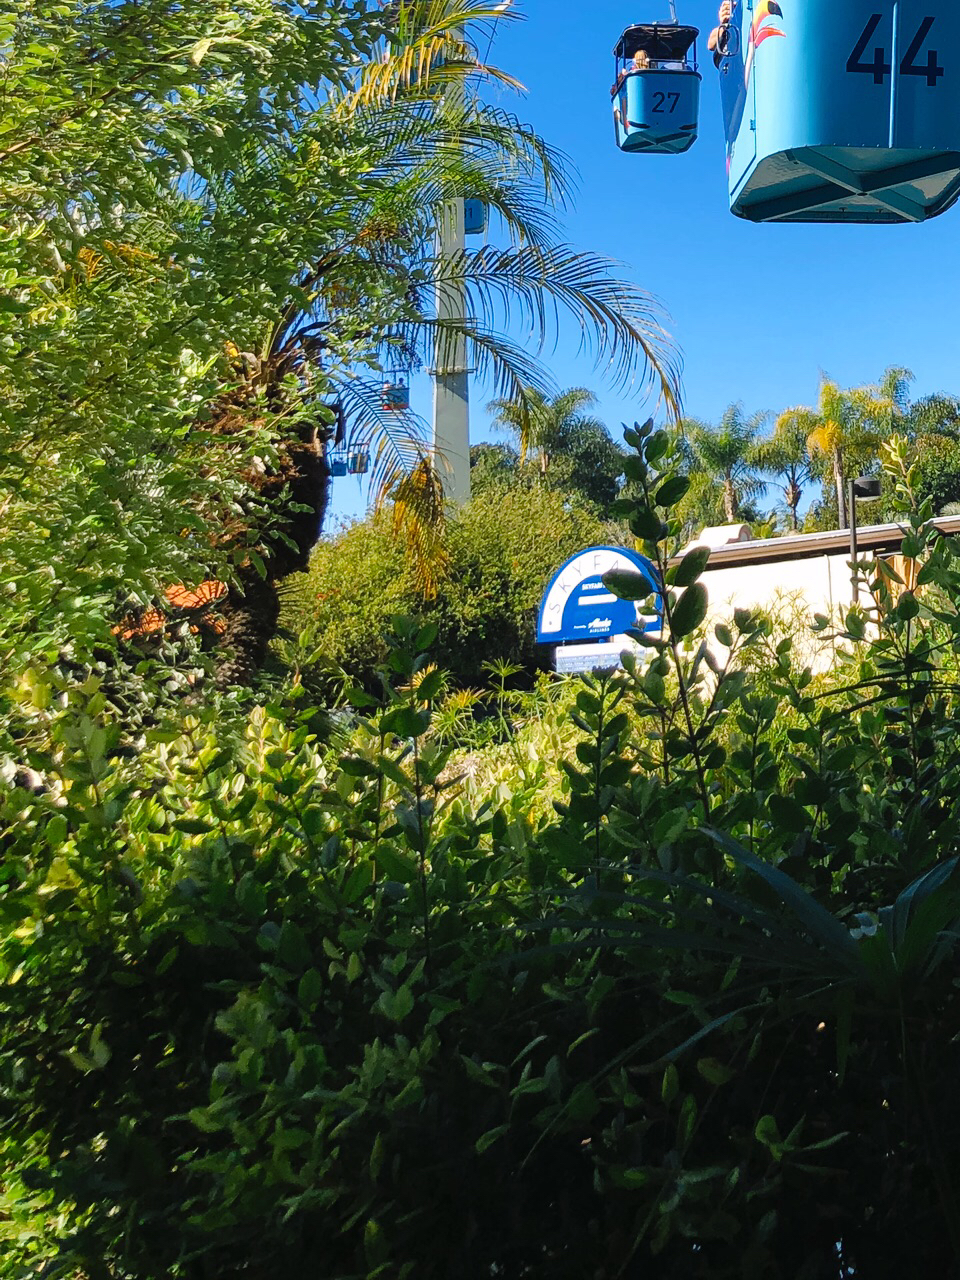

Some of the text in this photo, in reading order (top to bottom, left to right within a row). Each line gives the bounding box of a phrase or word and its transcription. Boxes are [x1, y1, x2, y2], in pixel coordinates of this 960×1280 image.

[846, 14, 944, 87] 44
[652, 92, 681, 114] 27
[549, 555, 619, 613] SKYFA
